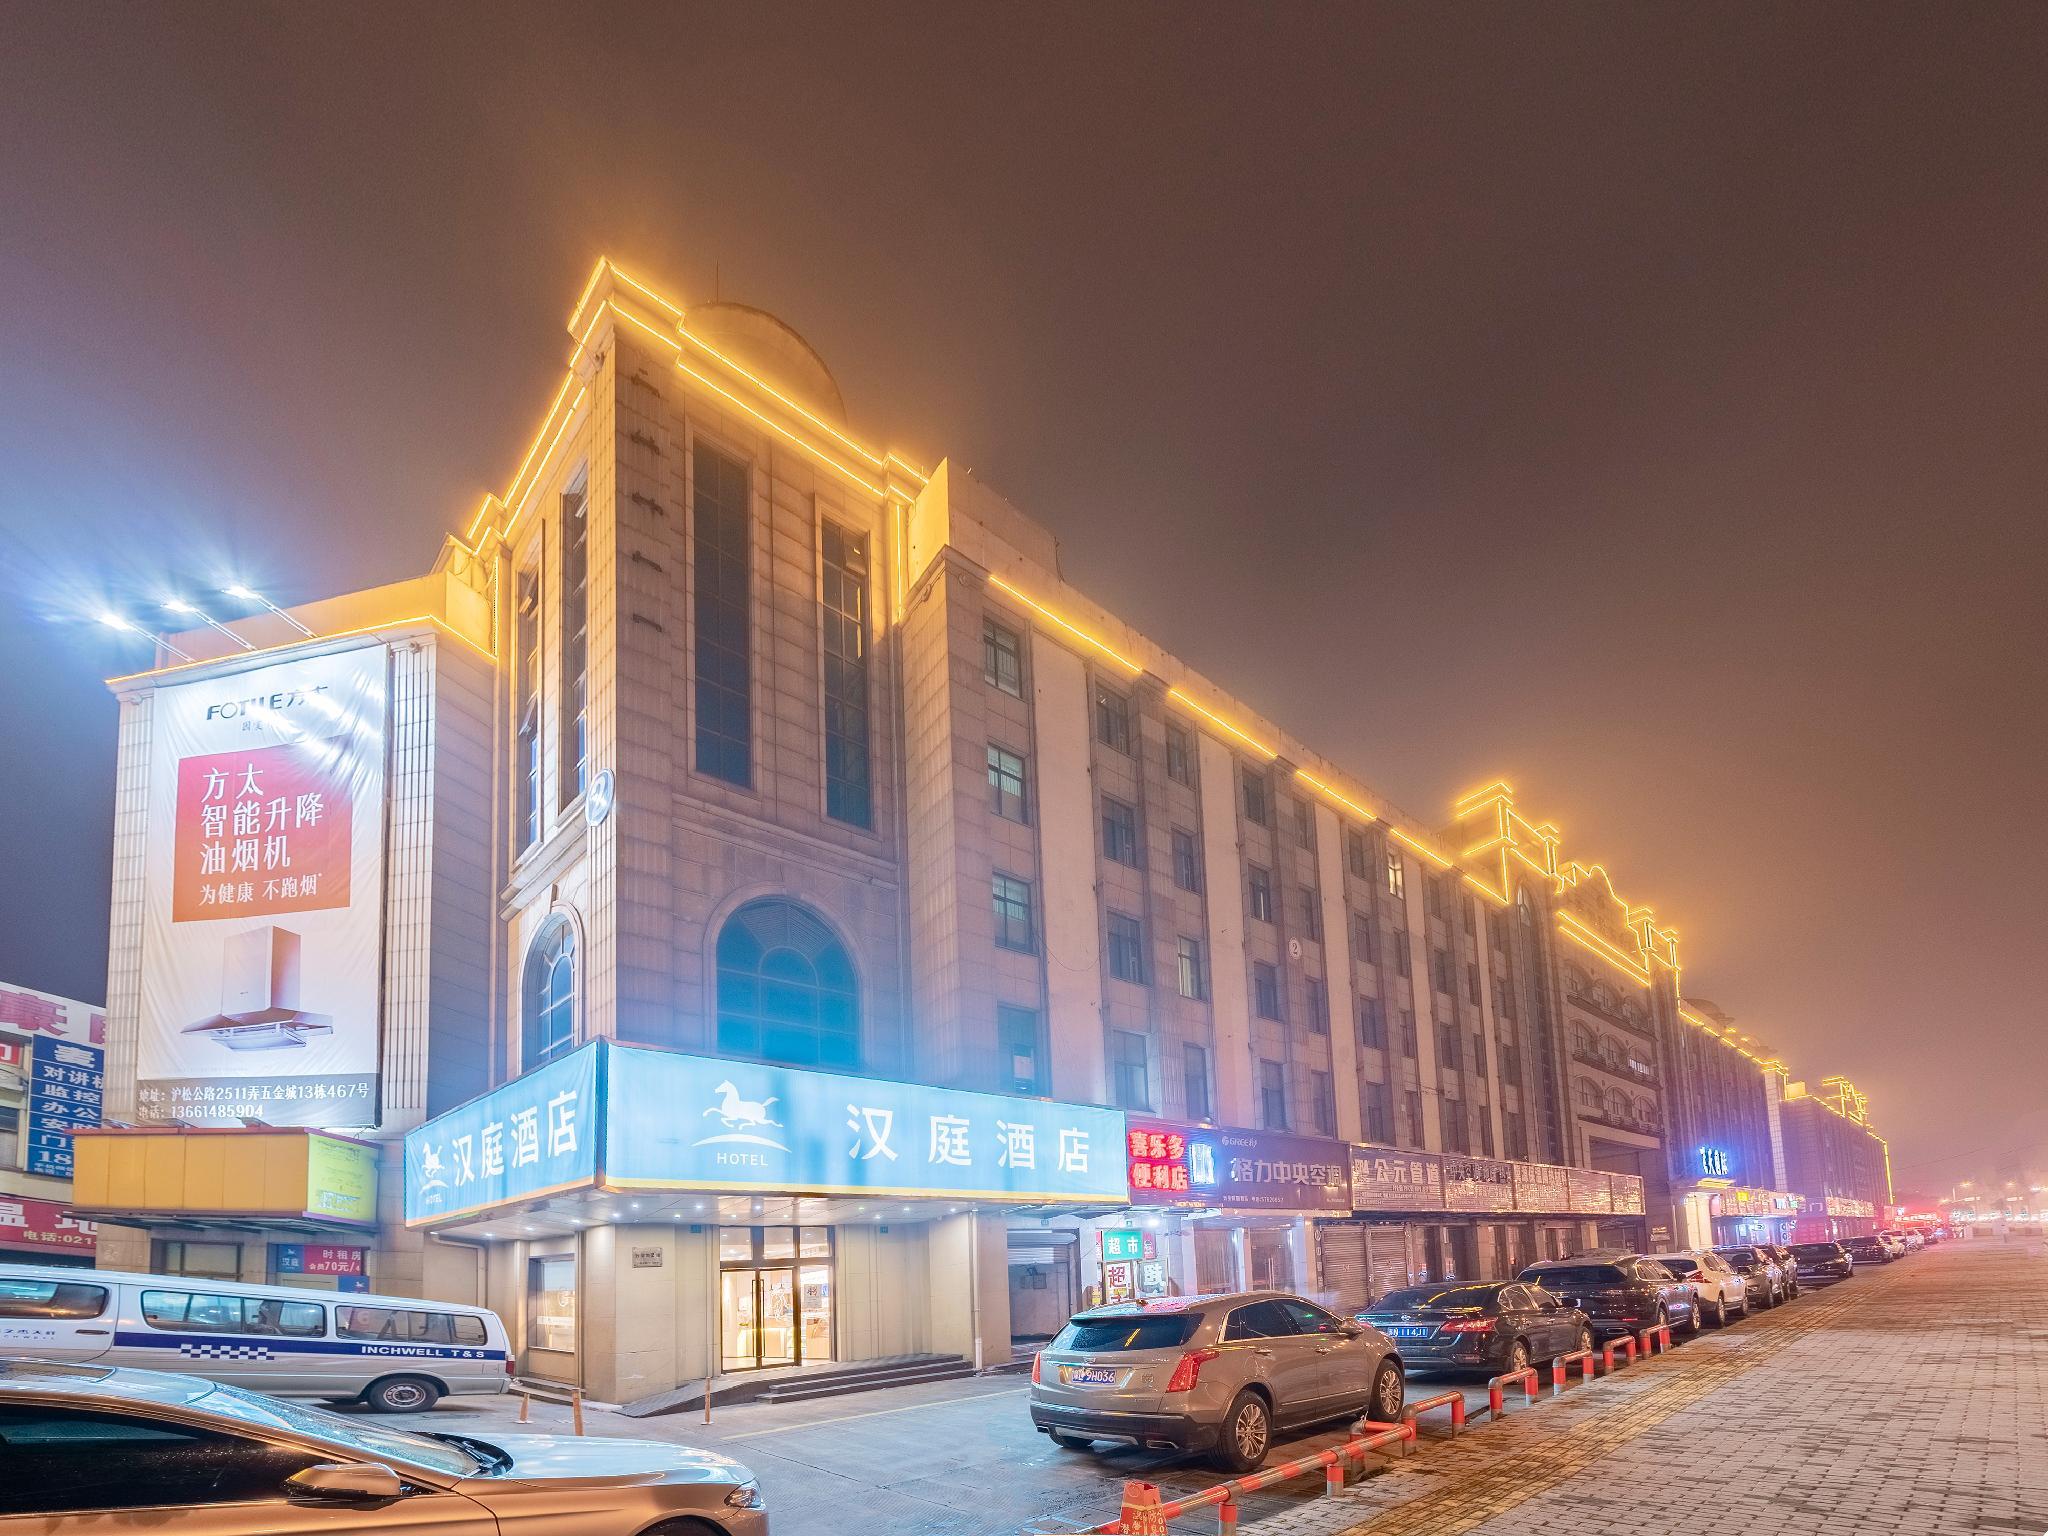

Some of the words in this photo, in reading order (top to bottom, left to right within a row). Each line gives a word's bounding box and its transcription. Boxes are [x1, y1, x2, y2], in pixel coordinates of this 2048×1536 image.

[200, 763, 264, 803] 方太
[200, 792, 324, 838] 智能升降
[199, 835, 291, 875] 油烟机
[198, 881, 255, 907] 为健康
[262, 873, 317, 901] 不跑烟
[42, 1084, 101, 1105] 监控
[41, 1101, 100, 1121] 办公
[452, 1089, 579, 1187] 汉庭酒店
[846, 1103, 1090, 1174] 汉庭酒店
[1129, 1130, 1185, 1160] 喜乐多
[716, 1151, 769, 1167] HOTEL
[1230, 1157, 1342, 1187] 格力中央空调
[1131, 1162, 1188, 1191] 便利店
[1107, 1235, 1139, 1255] 超市
[361, 1346, 444, 1357] INCHWELL
